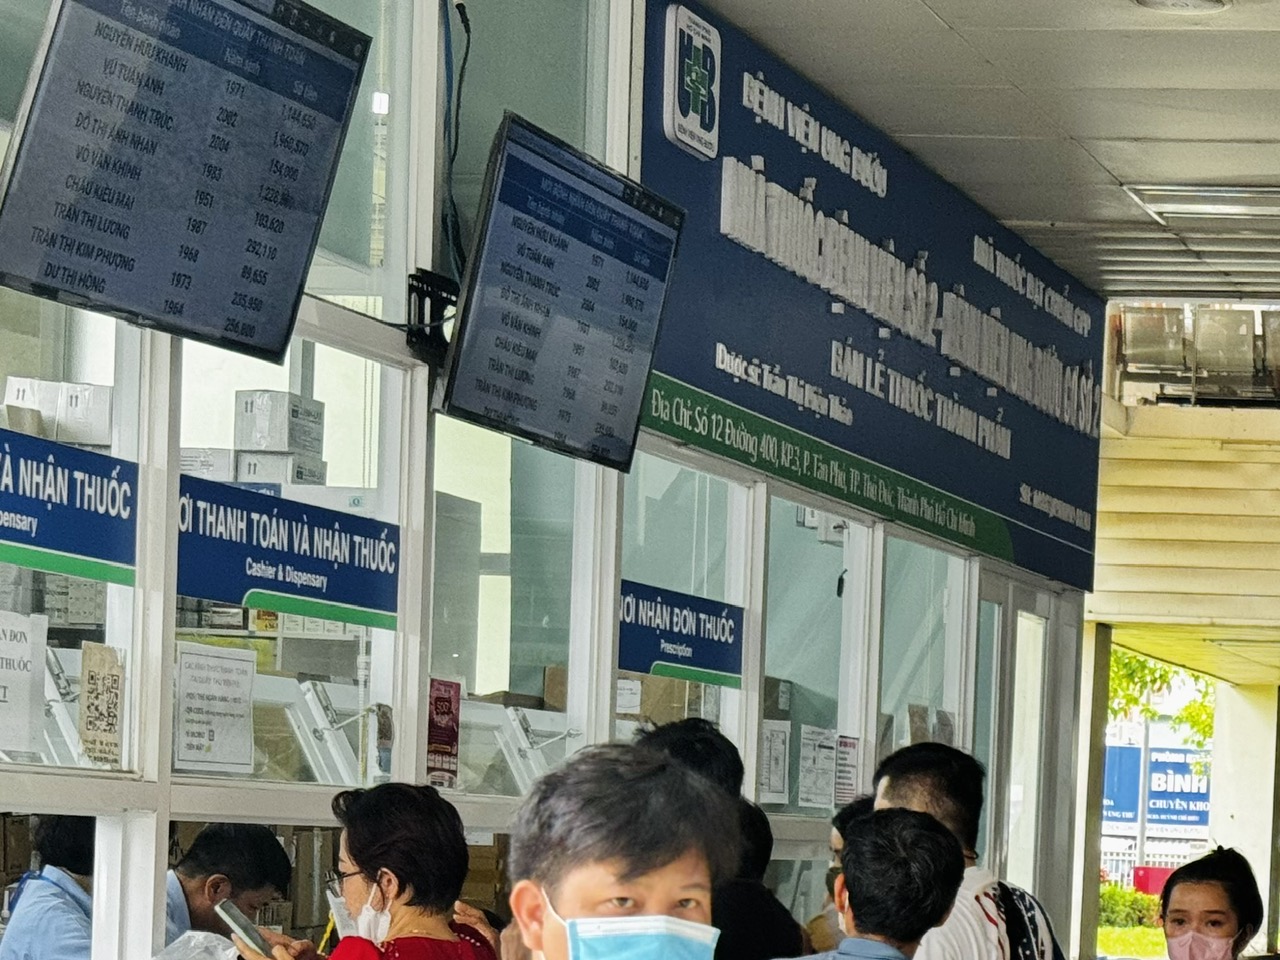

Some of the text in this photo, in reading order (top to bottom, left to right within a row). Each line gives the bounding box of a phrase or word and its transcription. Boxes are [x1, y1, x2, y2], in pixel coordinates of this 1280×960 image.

[80, 210, 97, 232] THỊ
[178, 244, 200, 263] 1968
[187, 217, 208, 235] 1987
[59, 234, 76, 257] THỊ
[75, 241, 96, 260] KIM
[170, 270, 192, 290] 1973
[60, 266, 78, 288] THỊ
[887, 370, 934, 421] THUỐC
[651, 388, 670, 425] Địa
[694, 404, 710, 436] Số
[711, 413, 723, 441] 12
[725, 418, 758, 463] Đường
[759, 432, 778, 468] 400,
[803, 450, 811, 476] P.
[0, 443, 131, 519] À NHẬN THUỐC
[178, 493, 396, 574] ƠI THANH TOÁN VÀ NHẬN THUỐC
[245, 557, 328, 592] Cashier & Dispensary
[9, 628, 28, 643] ĐƠN
[638, 596, 671, 635] NHẬN
[673, 606, 697, 637] ĐƠN
[699, 608, 735, 644] THUỐC
[660, 639, 693, 658] Prescription
[1151, 770, 1208, 794] BÌNH
[1149, 798, 1189, 811] CHUYÊN
